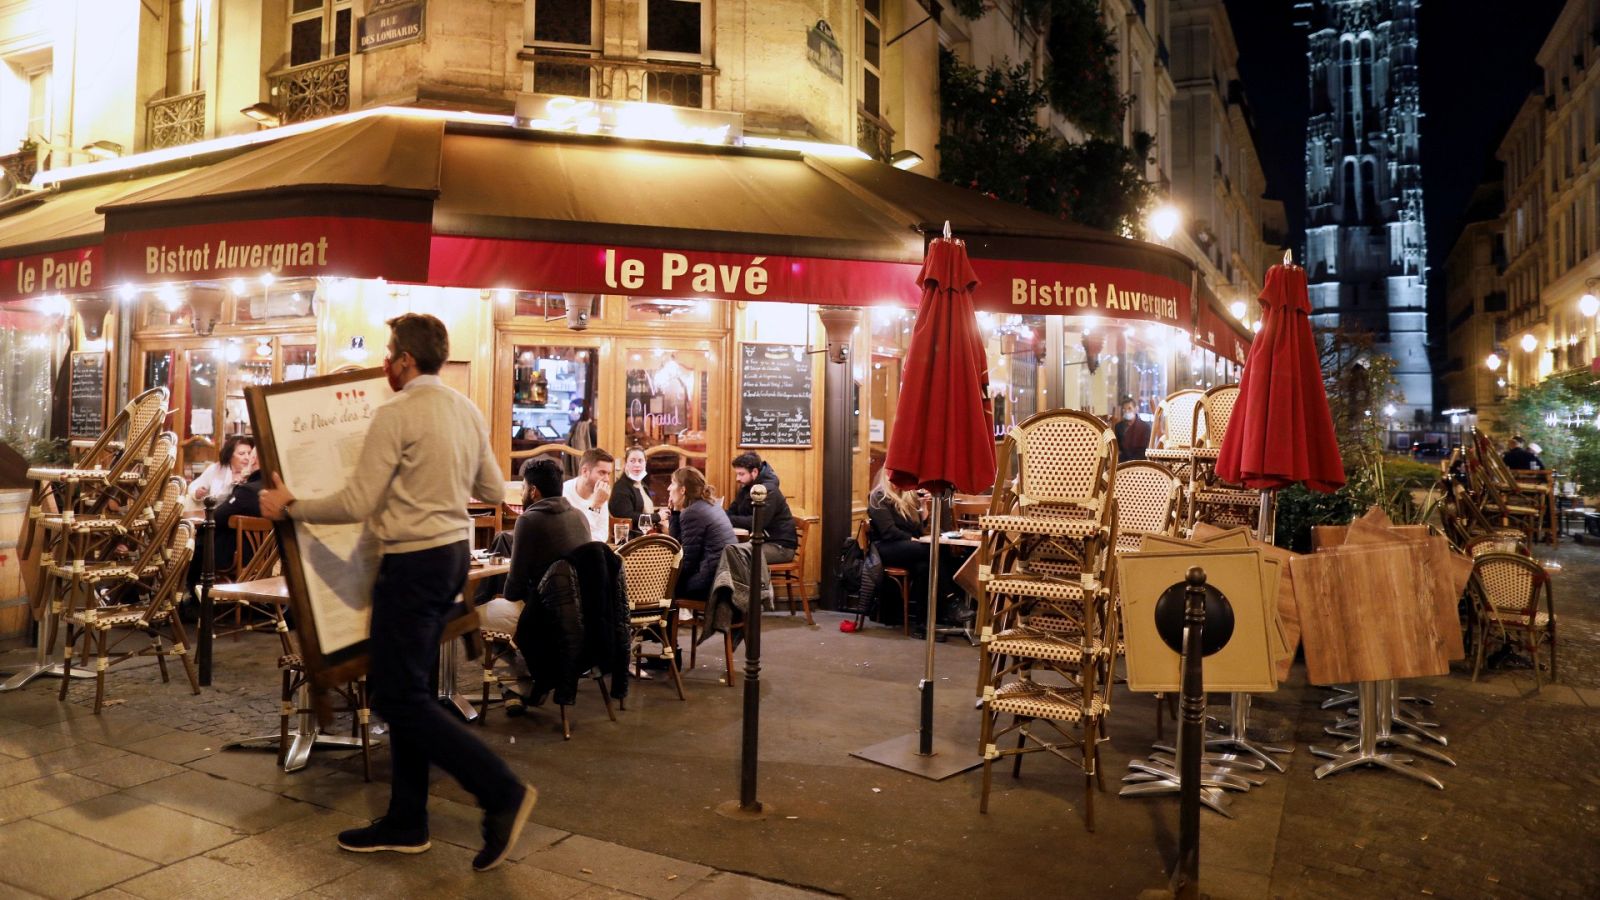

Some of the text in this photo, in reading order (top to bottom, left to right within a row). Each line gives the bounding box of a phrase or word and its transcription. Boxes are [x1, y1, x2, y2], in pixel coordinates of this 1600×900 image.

[361, 24, 419, 47] DES LOMBARDS
[380, 15, 398, 28] RUE
[17, 250, 92, 294] le Pavé
[146, 236, 328, 274] Bistrot Auvergnat
[604, 249, 768, 295] le Pavé
[1012, 278, 1178, 320] Bistrot Auvergnat
[291, 416, 308, 433] Le
[310, 413, 337, 430] Pavé
[339, 408, 360, 423] des
[630, 398, 682, 433] Chaud
